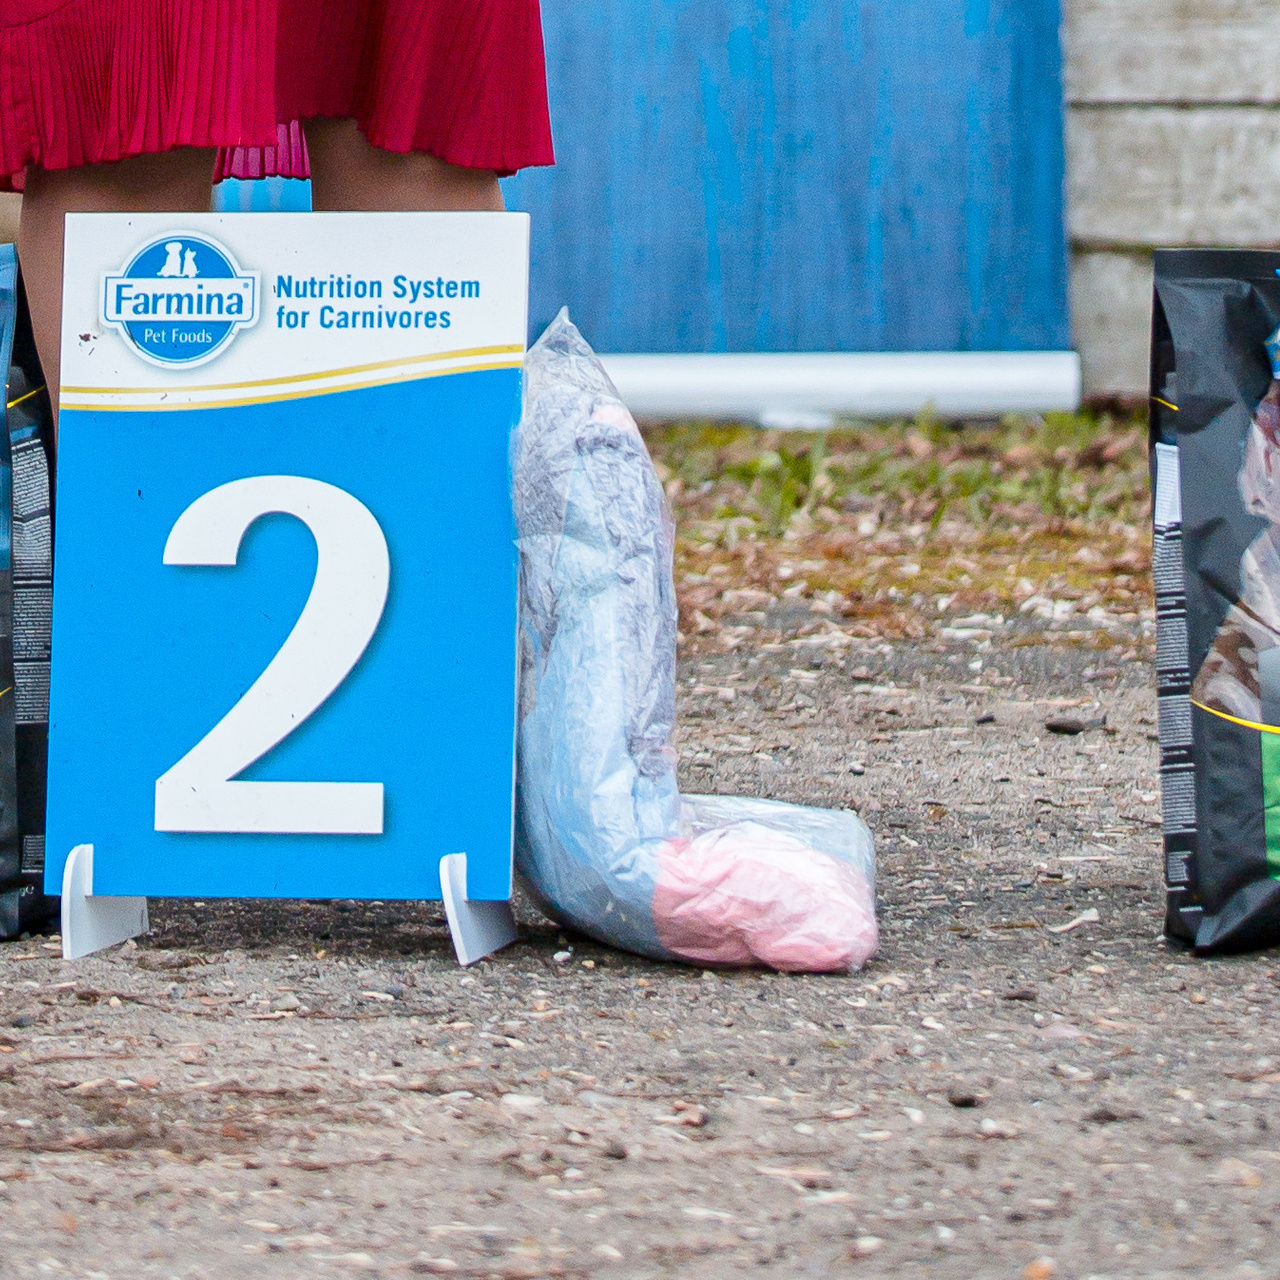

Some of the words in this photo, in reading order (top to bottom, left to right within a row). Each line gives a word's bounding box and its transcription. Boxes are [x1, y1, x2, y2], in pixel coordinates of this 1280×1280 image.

[115, 283, 244, 315] Farmina
[276, 274, 383, 299] Nutrition
[392, 274, 481, 304] System
[276, 305, 310, 329] for
[319, 304, 452, 329] Carnivores
[144, 328, 167, 343] Pet
[172, 327, 213, 343] Foods
[154, 474, 391, 835] 2
